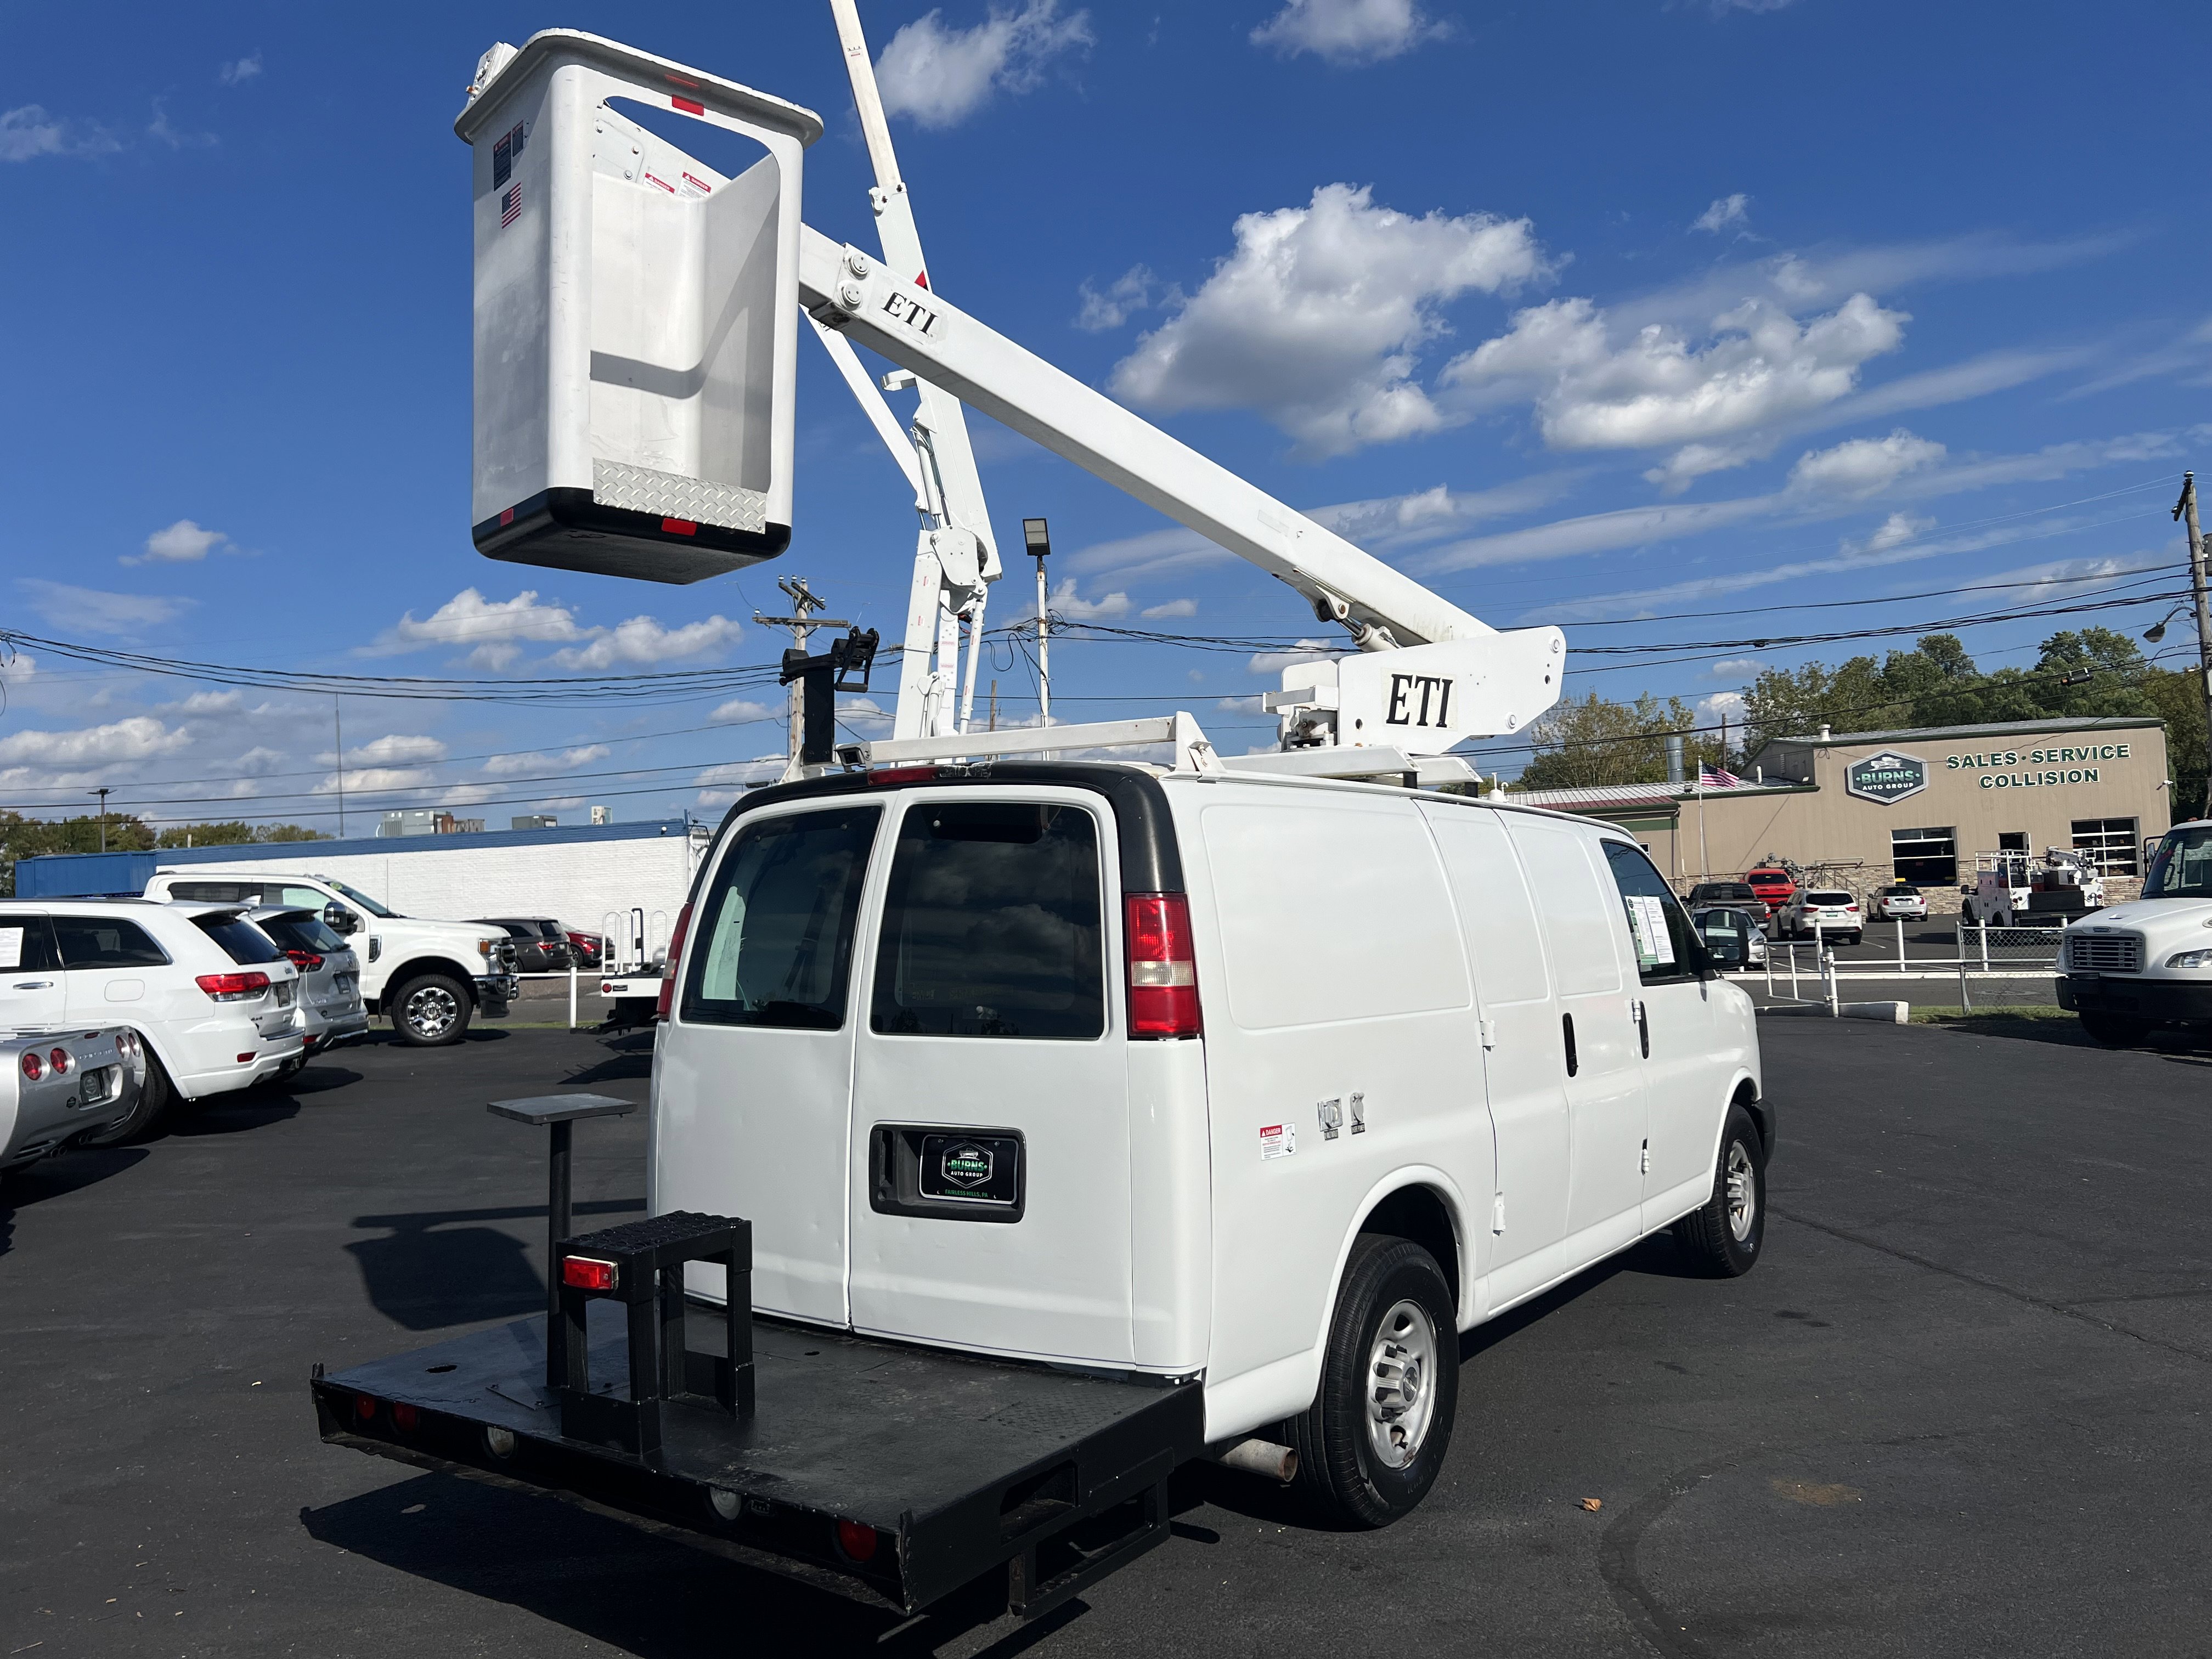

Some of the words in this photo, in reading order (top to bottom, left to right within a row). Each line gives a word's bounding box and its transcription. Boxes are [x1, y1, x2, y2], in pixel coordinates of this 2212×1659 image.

[691, 178, 708, 190] DANGER
[1386, 674, 1453, 727] ETI
[1946, 751, 2018, 769] SALES
[2030, 743, 2130, 764] SERVICE
[1861, 770, 1914, 784] BURNS
[1979, 768, 2100, 789] COLLISION
[881, 840, 939, 884] ETI
[951, 1159, 984, 1171] BURNS
